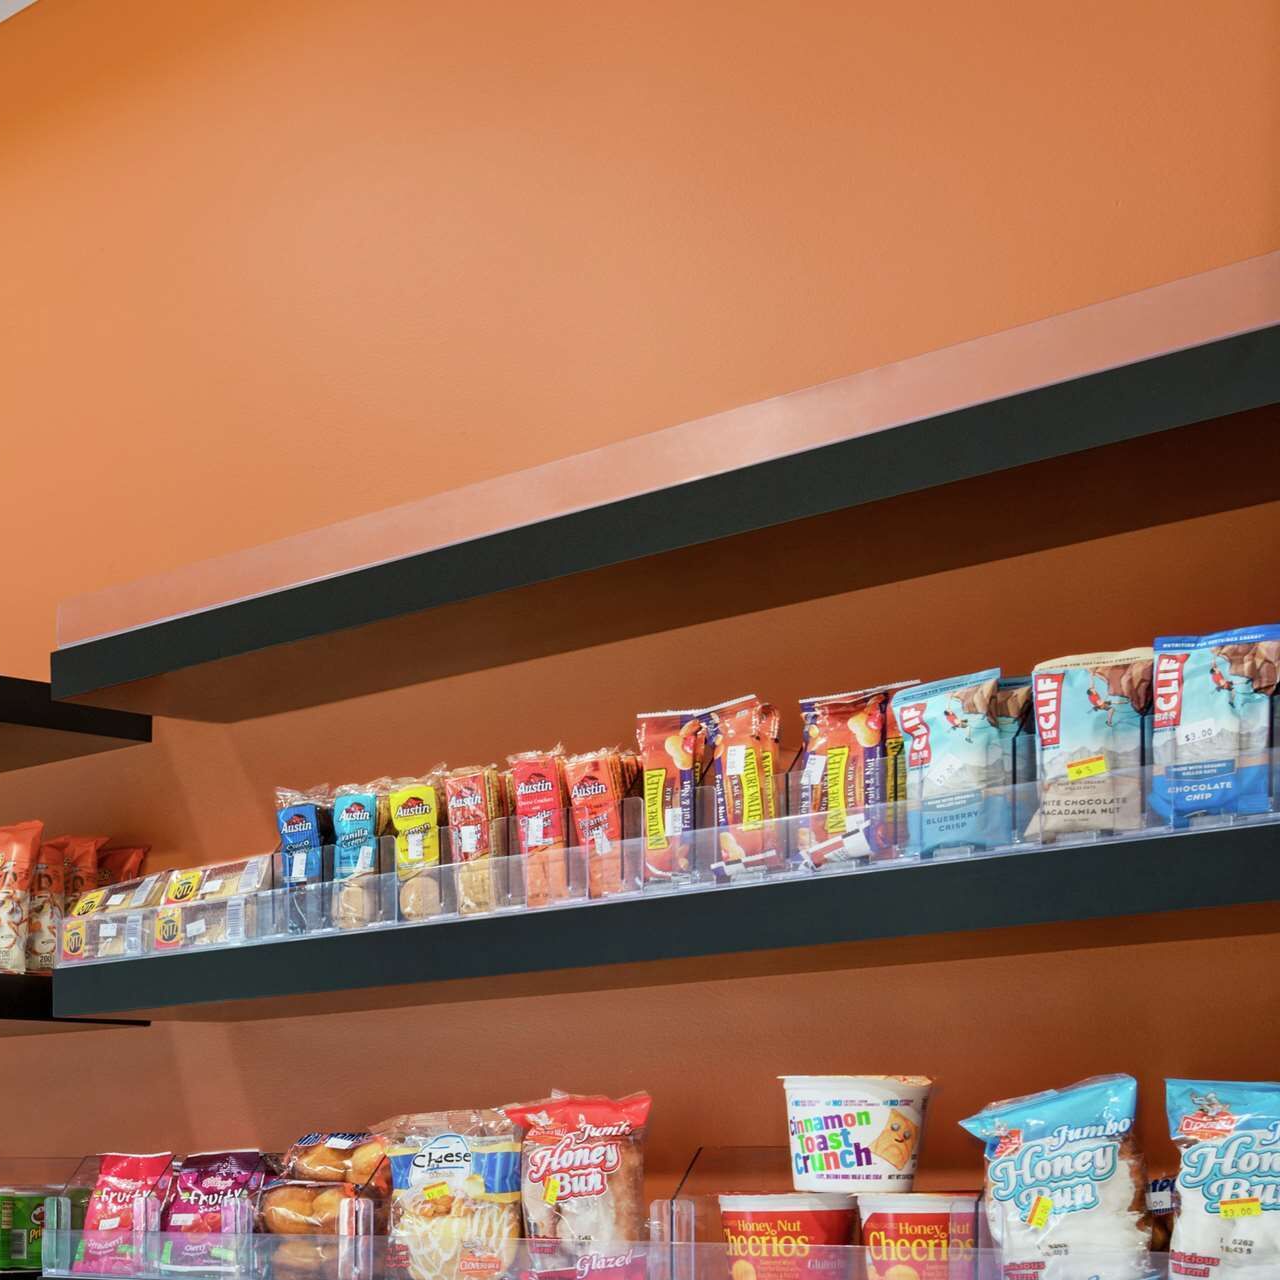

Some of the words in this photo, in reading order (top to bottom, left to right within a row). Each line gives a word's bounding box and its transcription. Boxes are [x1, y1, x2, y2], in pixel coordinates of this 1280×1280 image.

[1156, 658, 1182, 711] CLIF
[1038, 676, 1059, 729] CLIF
[1154, 710, 1177, 721] BAR
[903, 705, 931, 752] CLIF
[1185, 727, 1213, 742] $3.00
[830, 748, 847, 789] VALLEY
[517, 780, 553, 797] Austin
[571, 782, 607, 801] Austin
[645, 770, 665, 807] VALLEY
[680, 780, 690, 799] Nut
[1167, 781, 1233, 794] CHOCOLATE
[449, 792, 483, 809] Austin
[1064, 797, 1128, 806] CHOCOLATE
[1185, 792, 1213, 802] CHIP
[340, 808, 370, 823] Austin
[395, 803, 432, 818] Austin
[827, 790, 846, 832] NATURE
[926, 811, 979, 825] BLUEBERRY
[1101, 806, 1121, 815] NUT
[281, 820, 312, 835] Austin
[647, 808, 667, 849] NATURE
[938, 821, 968, 832] CRISP
[170, 884, 194, 898] RITZ
[159, 925, 178, 940] RITZ
[1050, 1118, 1132, 1149] Jumbo
[412, 1151, 472, 1169] Cheese
[531, 1141, 620, 1178] Honey
[1182, 1136, 1280, 1188] Hon
[991, 1144, 1119, 1194] Honey
[551, 1172, 606, 1196] Bun
[1223, 1206, 1253, 1218] $3.00
[737, 1220, 771, 1234] Honey
[777, 1220, 801, 1232] Nut
[898, 1222, 942, 1237] Honey
[948, 1223, 970, 1234] Nut
[870, 1231, 975, 1262] Cheerios
[576, 1253, 632, 1279] Glazed
